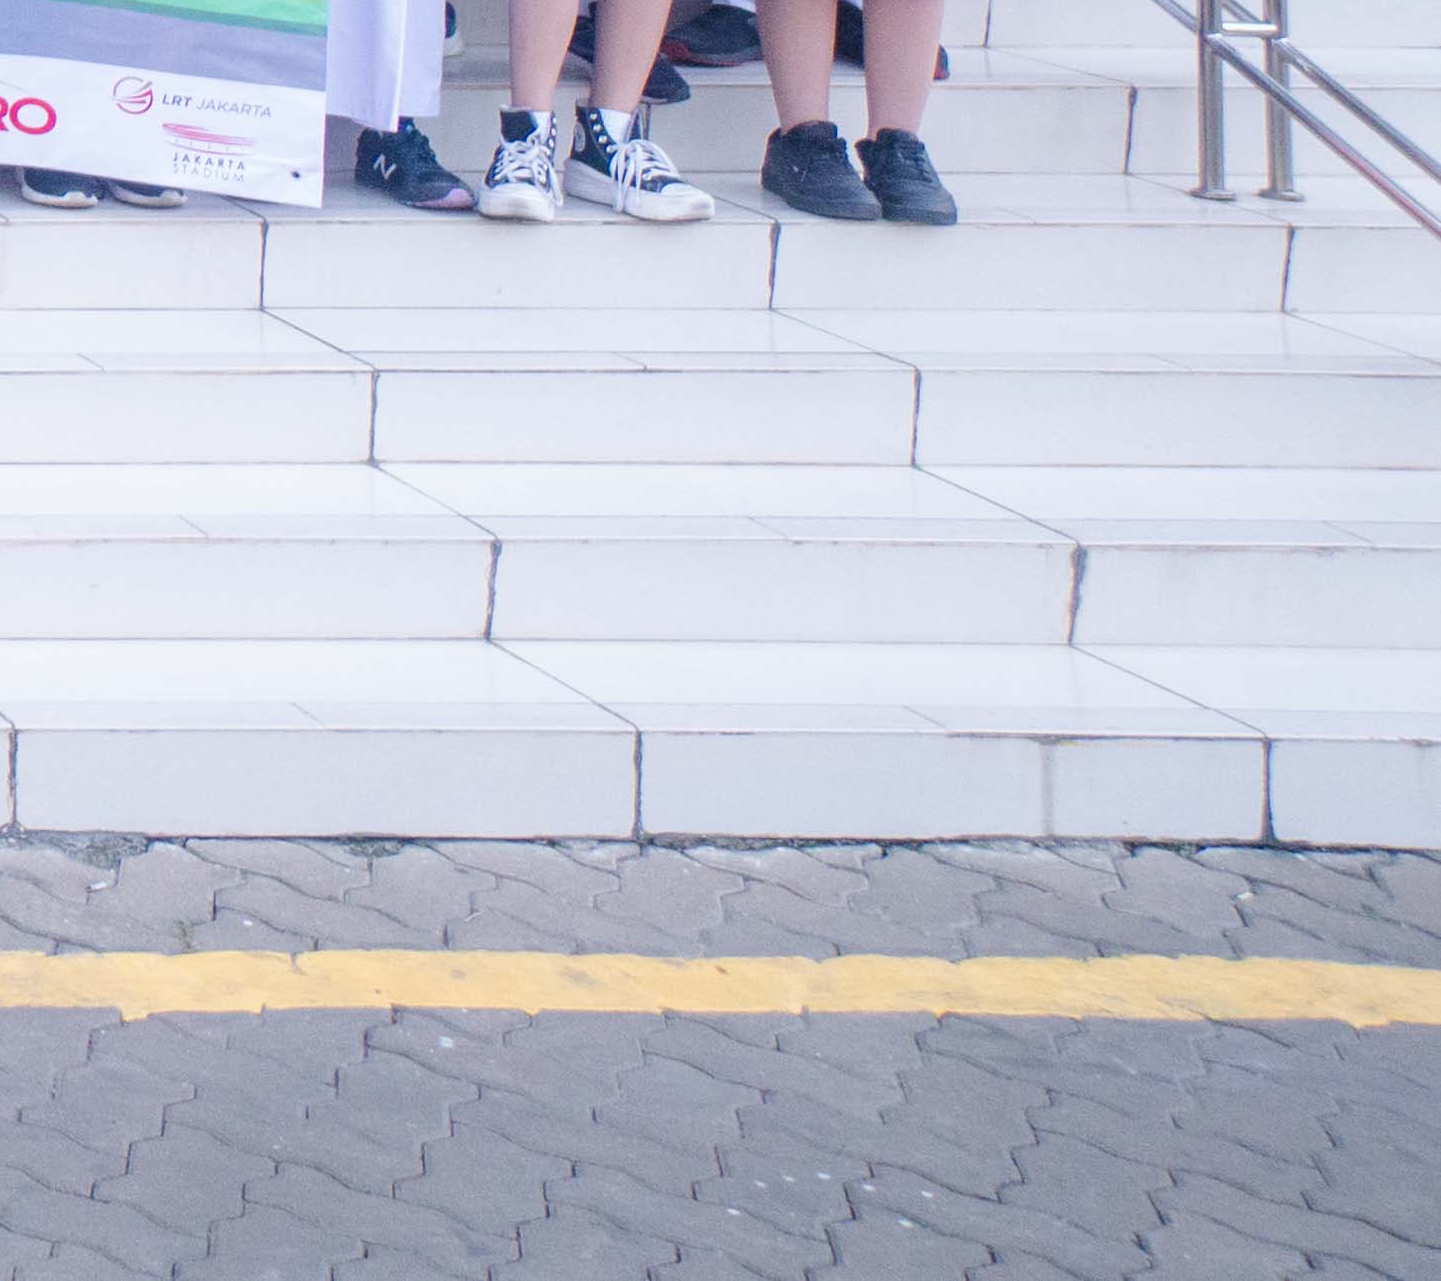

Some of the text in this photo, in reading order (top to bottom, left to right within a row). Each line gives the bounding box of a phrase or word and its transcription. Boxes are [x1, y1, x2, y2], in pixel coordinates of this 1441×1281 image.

[162, 94, 271, 118] LRT JAKARTA
[173, 153, 245, 170] JAKARTA
